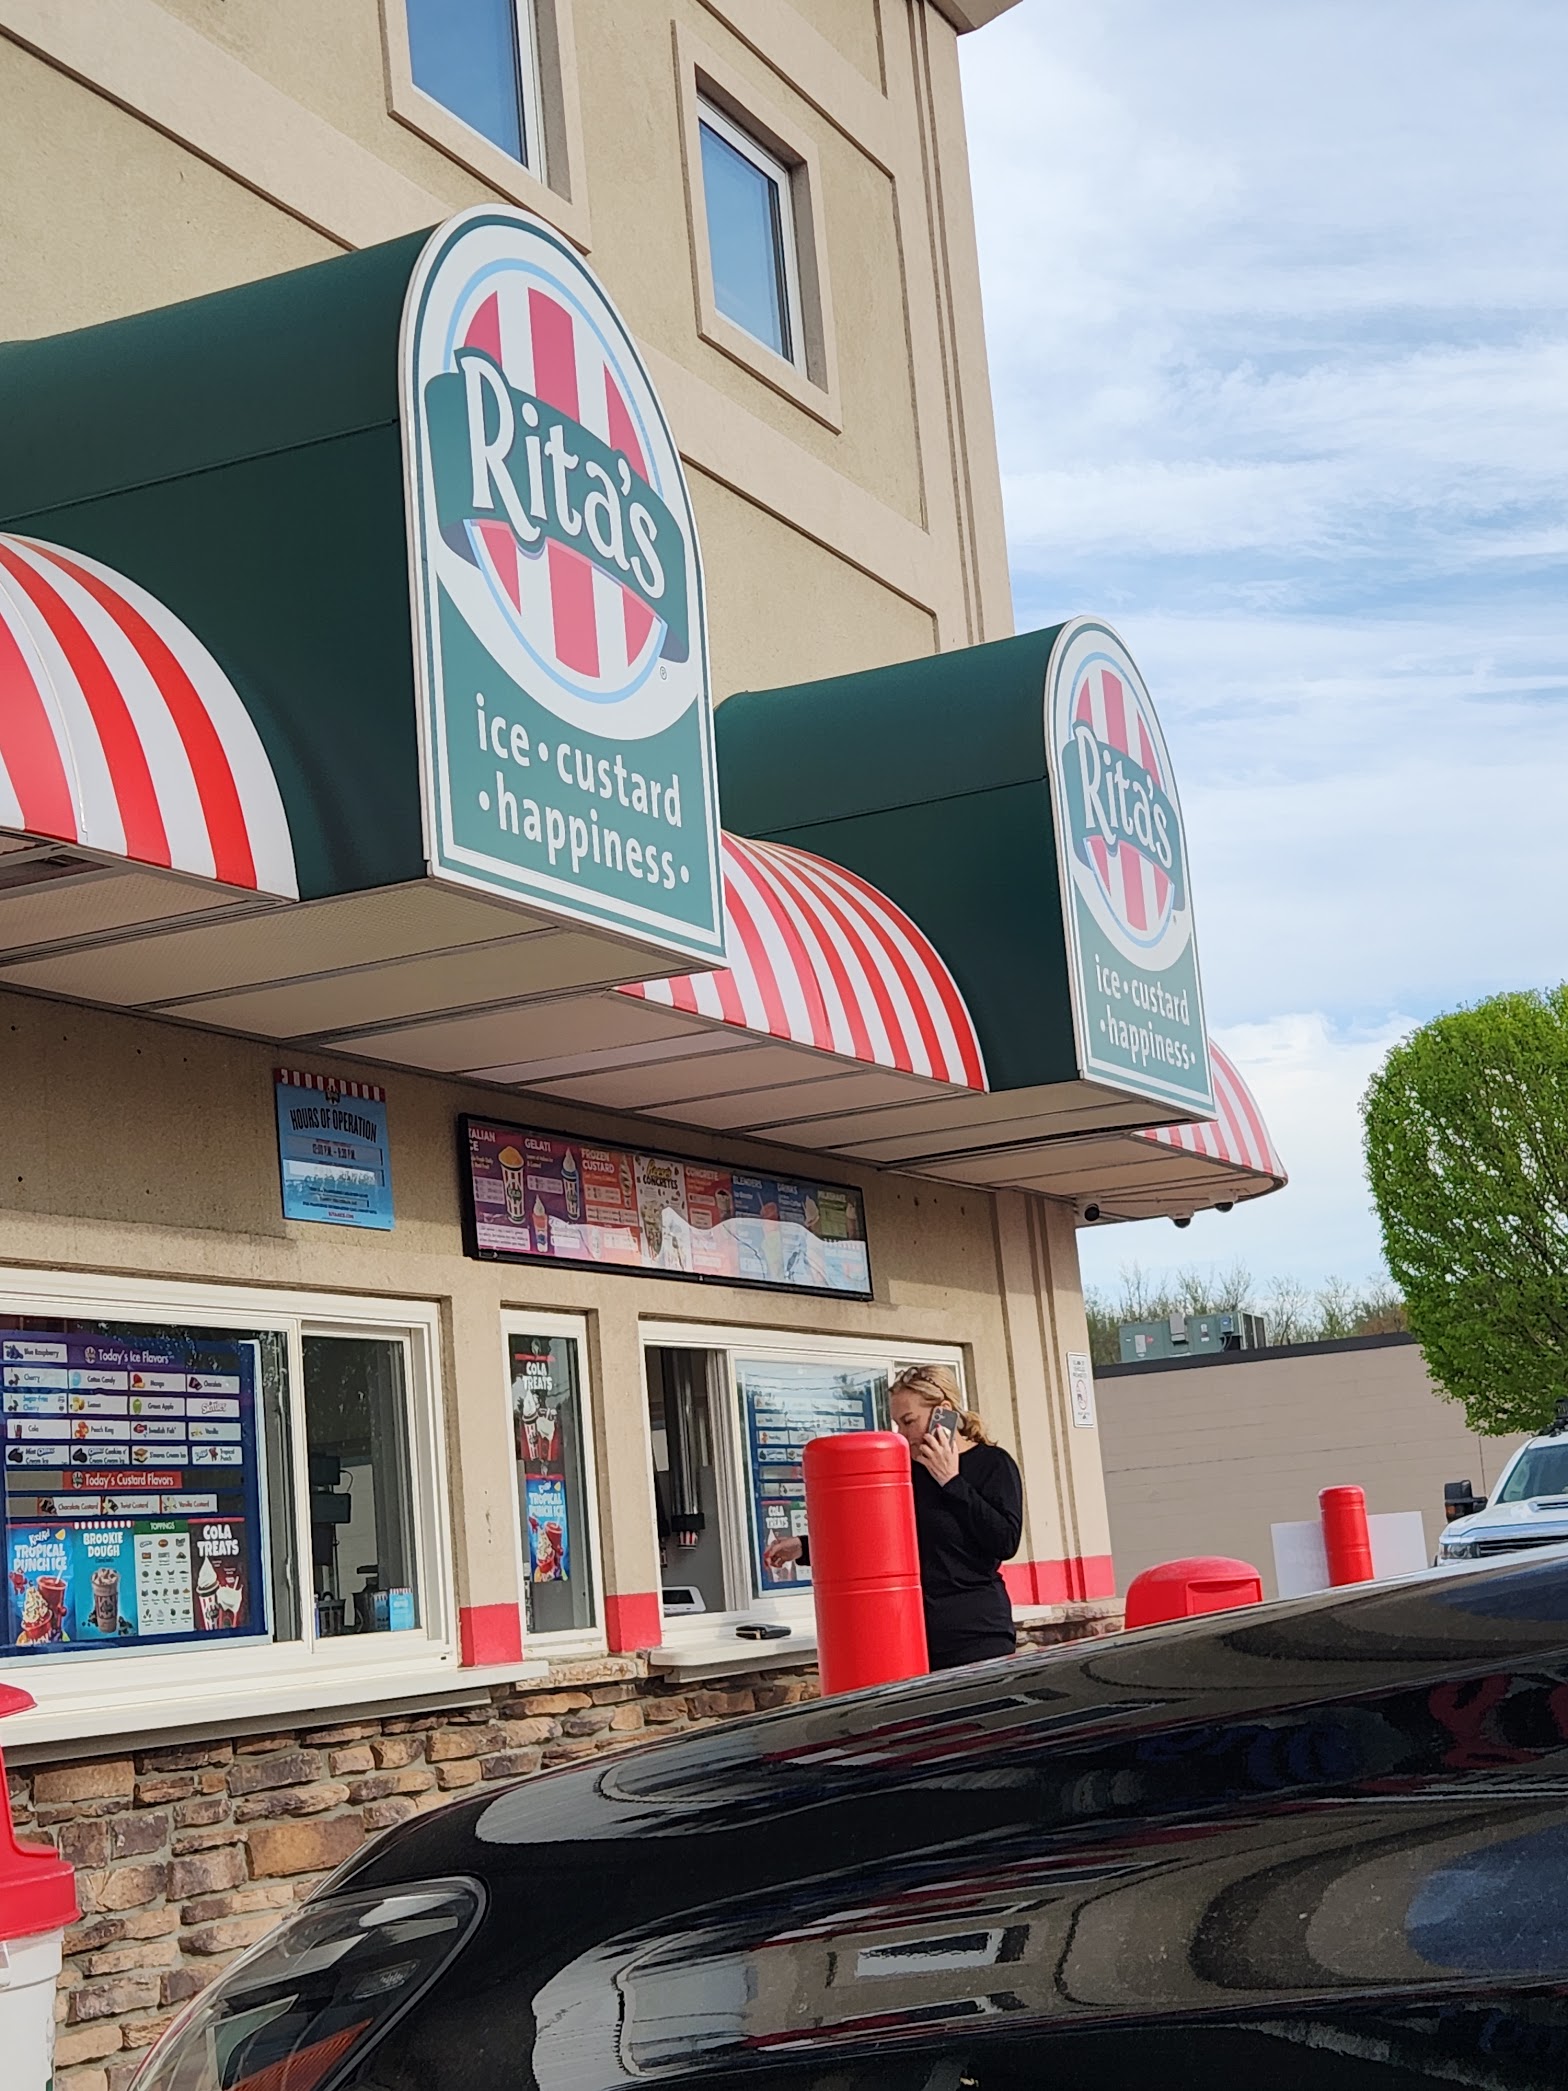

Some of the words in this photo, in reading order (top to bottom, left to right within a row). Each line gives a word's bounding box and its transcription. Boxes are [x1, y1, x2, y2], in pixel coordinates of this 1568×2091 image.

[463, 354, 667, 599] Rita's
[476, 691, 531, 763] ice
[556, 740, 683, 829] custard
[1074, 725, 1172, 869] Rita's
[496, 772, 678, 890] happiness
[1095, 954, 1122, 999] ice
[1131, 980, 1190, 1026] custard
[1108, 1006, 1189, 1071] happiness
[290, 1107, 320, 1130] HOURS
[321, 1109, 331, 1129] OF
[332, 1112, 378, 1143] OPERATION
[468, 1127, 496, 1142] TALIAN
[469, 1140, 479, 1151] CE
[525, 1138, 551, 1152] GELATI
[581, 1148, 610, 1162] FROZEN
[582, 1159, 615, 1174] CUSTARD
[642, 1174, 678, 1190] CONCRETES
[98, 1349, 128, 1365] Today's
[130, 1351, 141, 1362] Ice
[142, 1350, 168, 1364] Flavors
[526, 1361, 547, 1376] COLA
[24, 1373, 40, 1383] Cherry
[522, 1375, 553, 1391] TREATS
[23, 1404, 39, 1413] Cherry
[85, 1473, 115, 1488] Today's
[116, 1473, 146, 1486] Custard
[147, 1472, 174, 1486] Flavors
[768, 1505, 785, 1517] COLA
[150, 1521, 175, 1530] TOPPINGS
[203, 1524, 232, 1540] COLA
[83, 1531, 124, 1545] BROOKIE
[14, 1543, 65, 1558] TROPICAL
[87, 1544, 120, 1558] DOUGH
[196, 1540, 239, 1557] TREATS
[13, 1558, 50, 1572] PUNCH
[51, 1556, 67, 1571] ICE
